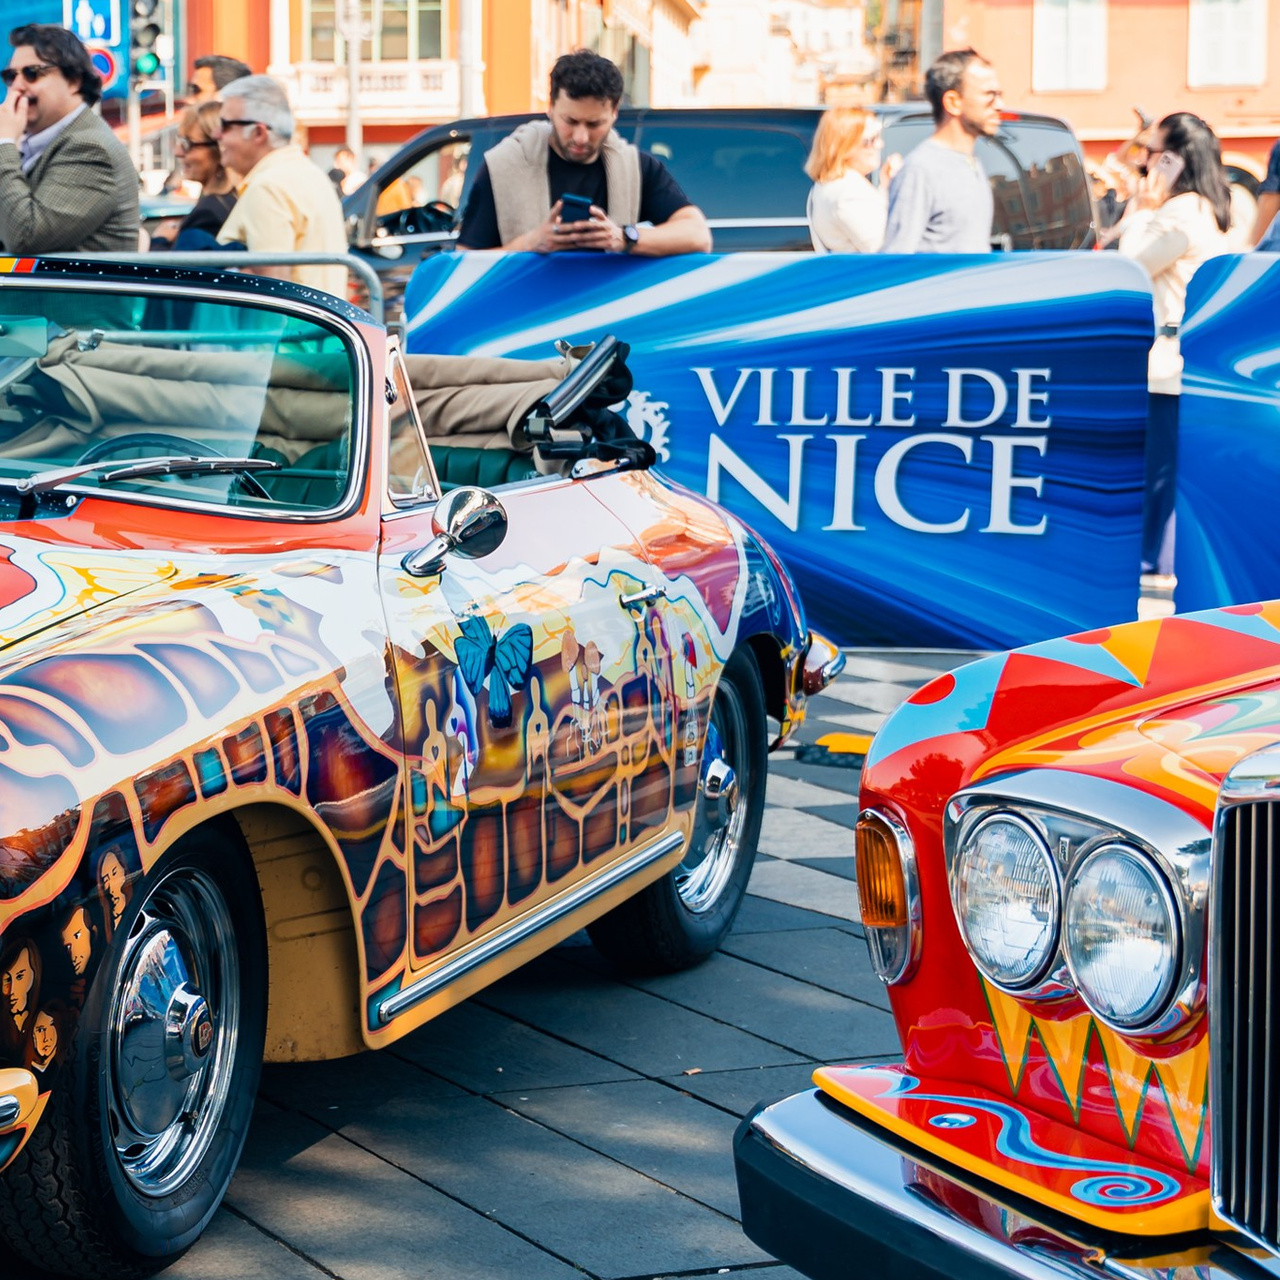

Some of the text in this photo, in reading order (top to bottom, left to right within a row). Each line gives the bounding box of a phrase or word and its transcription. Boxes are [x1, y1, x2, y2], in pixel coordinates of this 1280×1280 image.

[689, 367, 1053, 429] VILLE DE
[706, 432, 1049, 536] NICE
